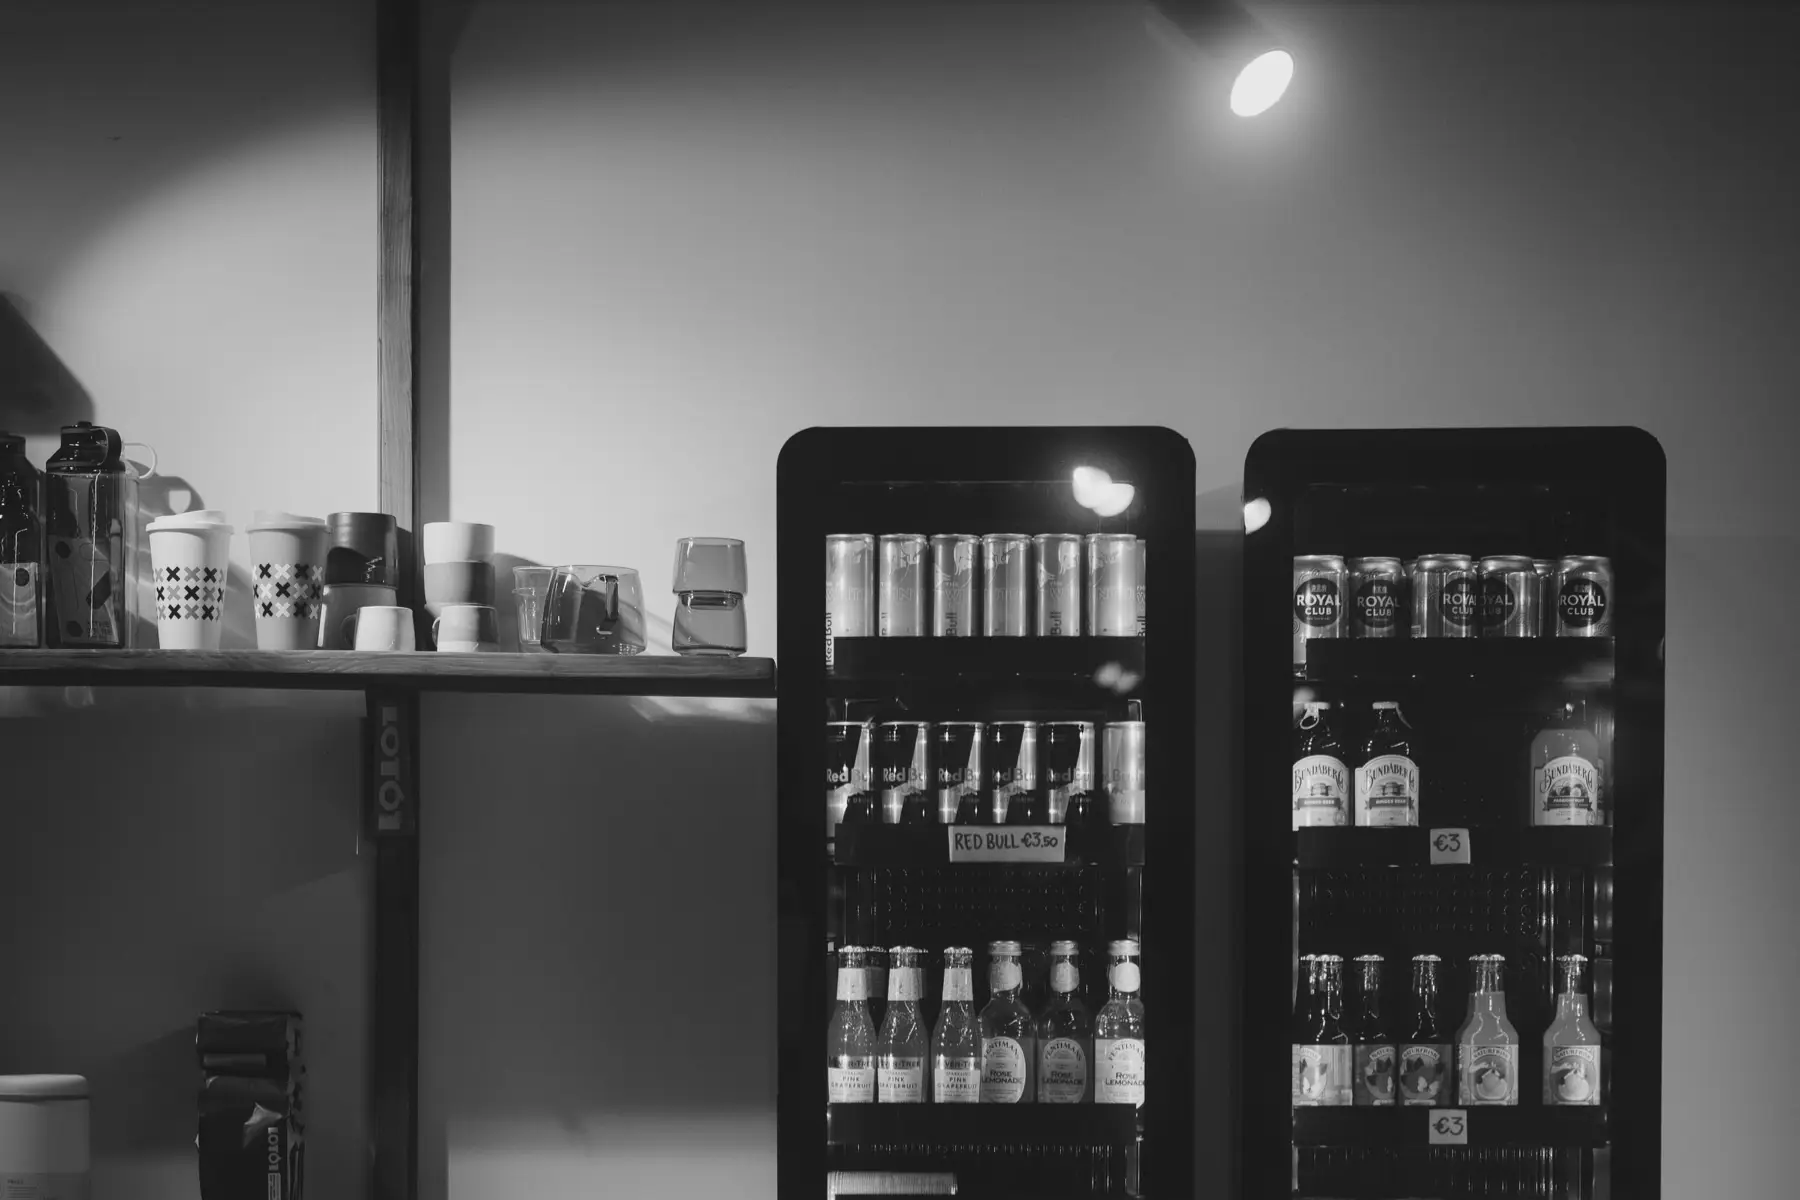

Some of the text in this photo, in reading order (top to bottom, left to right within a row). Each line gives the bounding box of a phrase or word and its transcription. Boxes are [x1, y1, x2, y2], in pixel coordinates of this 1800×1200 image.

[1296, 594, 1341, 606] ROYAL
[1357, 596, 1400, 608] ROYAL
[1558, 594, 1604, 607] ROYAL
[1304, 607, 1332, 615] CLUB
[1365, 608, 1392, 616] CLUB
[1567, 607, 1595, 616] CLUB
[826, 767, 848, 782] Red
[883, 767, 905, 782] Red
[955, 832, 1059, 850] RED BULL €3.50
[1433, 832, 1461, 852] €3
[1432, 1116, 1464, 1136] €3
